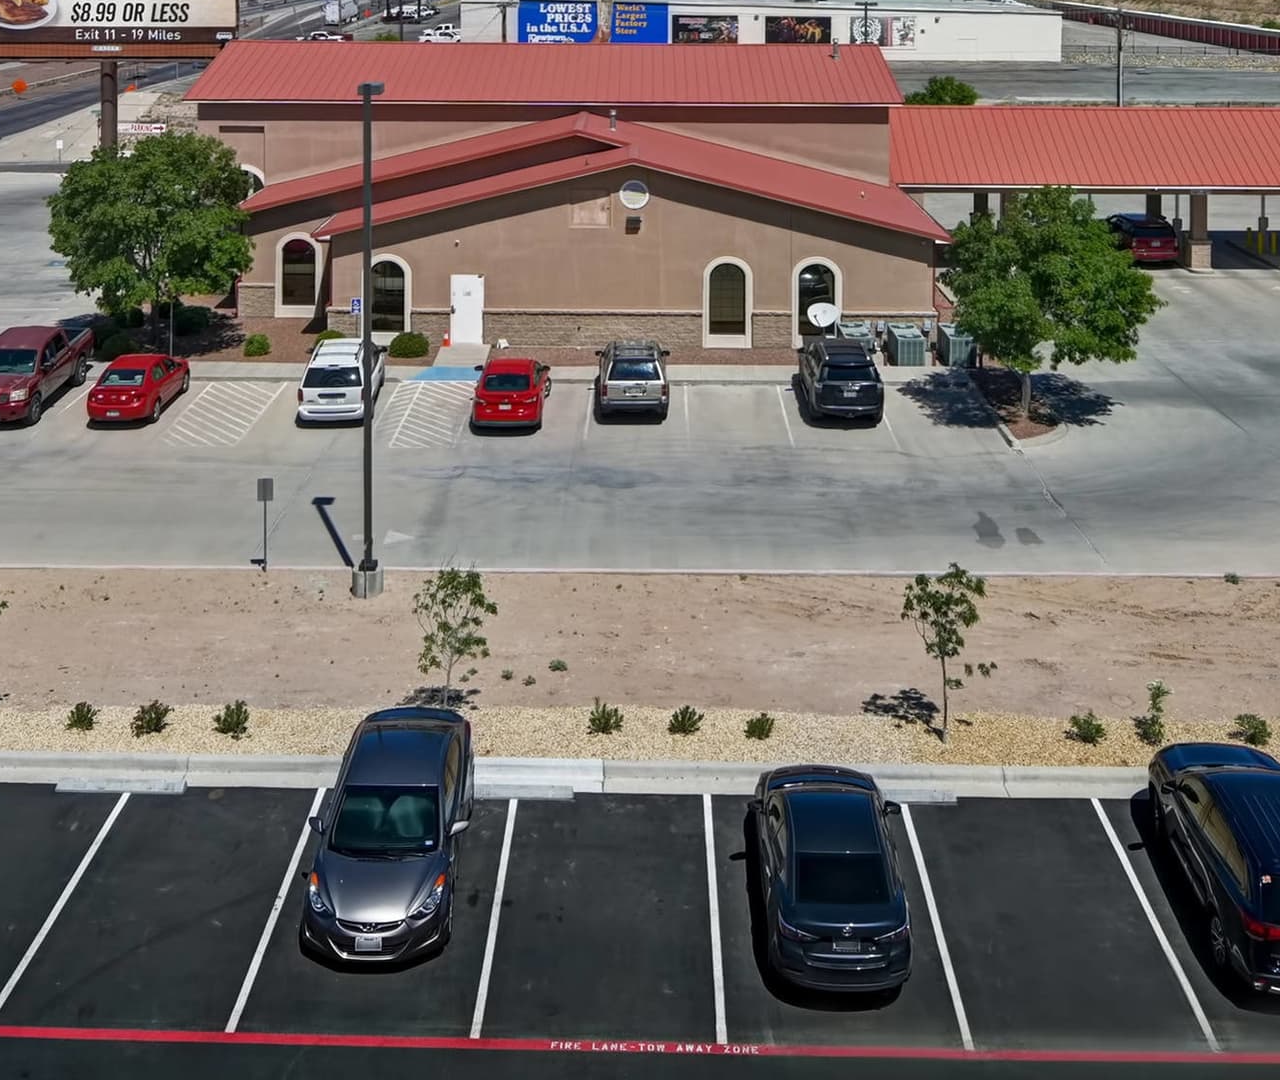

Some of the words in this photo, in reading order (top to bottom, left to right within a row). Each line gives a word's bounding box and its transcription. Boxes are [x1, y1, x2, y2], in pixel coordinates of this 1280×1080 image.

[71, 2, 116, 23] $8.99
[122, 3, 145, 22] OR
[150, 3, 190, 22] LESS
[539, 3, 592, 13] LOWEST
[546, 13, 592, 23] PRICES
[615, 11, 647, 20] Largest
[526, 23, 538, 32] in
[539, 23, 558, 32] the
[559, 23, 591, 32] U.S.A.
[615, 20, 648, 28] Factory
[75, 29, 100, 40] Exit
[104, 29, 116, 40] 11
[131, 29, 144, 40] 19
[148, 29, 181, 40] Miles
[550, 1041, 581, 1050] FIRE
[676, 1044, 712, 1053] AWAY
[723, 1045, 760, 1055] ZONE
